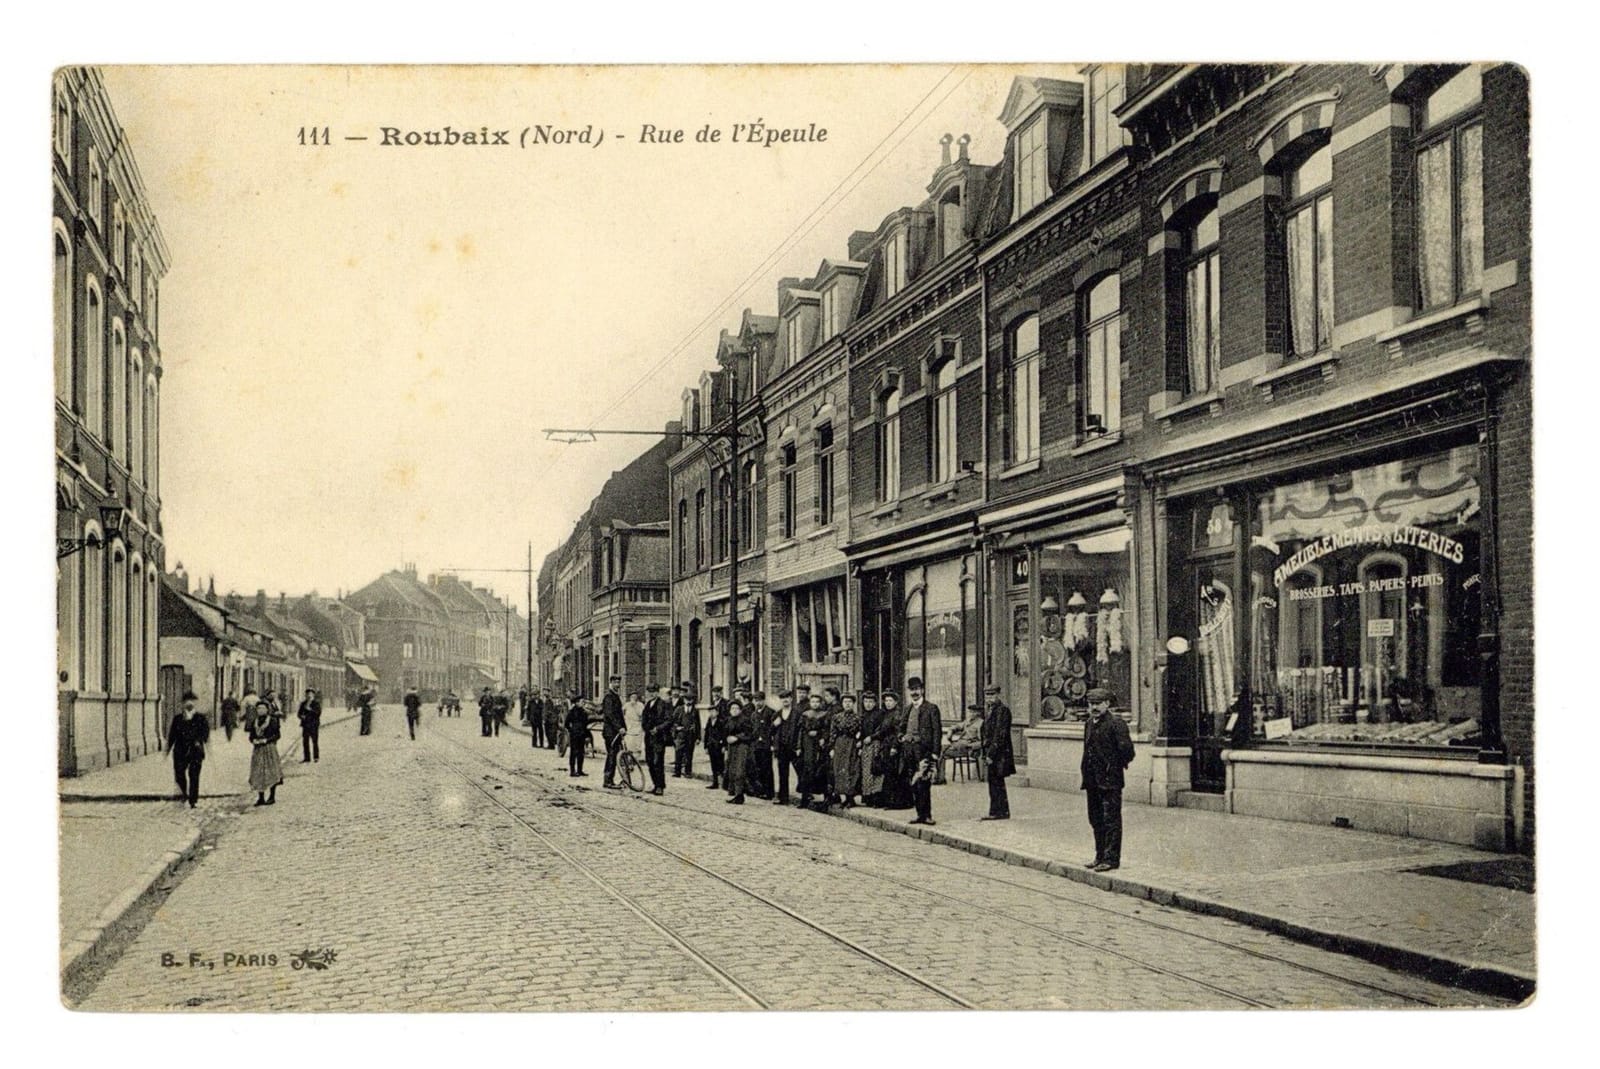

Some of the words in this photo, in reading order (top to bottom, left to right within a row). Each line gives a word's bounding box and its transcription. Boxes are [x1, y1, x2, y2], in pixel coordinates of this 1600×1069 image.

[1016, 560, 1029, 577] 40
[1272, 523, 1382, 588] AMEUBLEMENTS
[1393, 524, 1465, 565] LITERIES
[1288, 585, 1336, 601] BROSSERIES
[1340, 581, 1366, 596] TAPIS
[1369, 576, 1407, 593] PAPIERS
[1411, 573, 1445, 589] PEINTS
